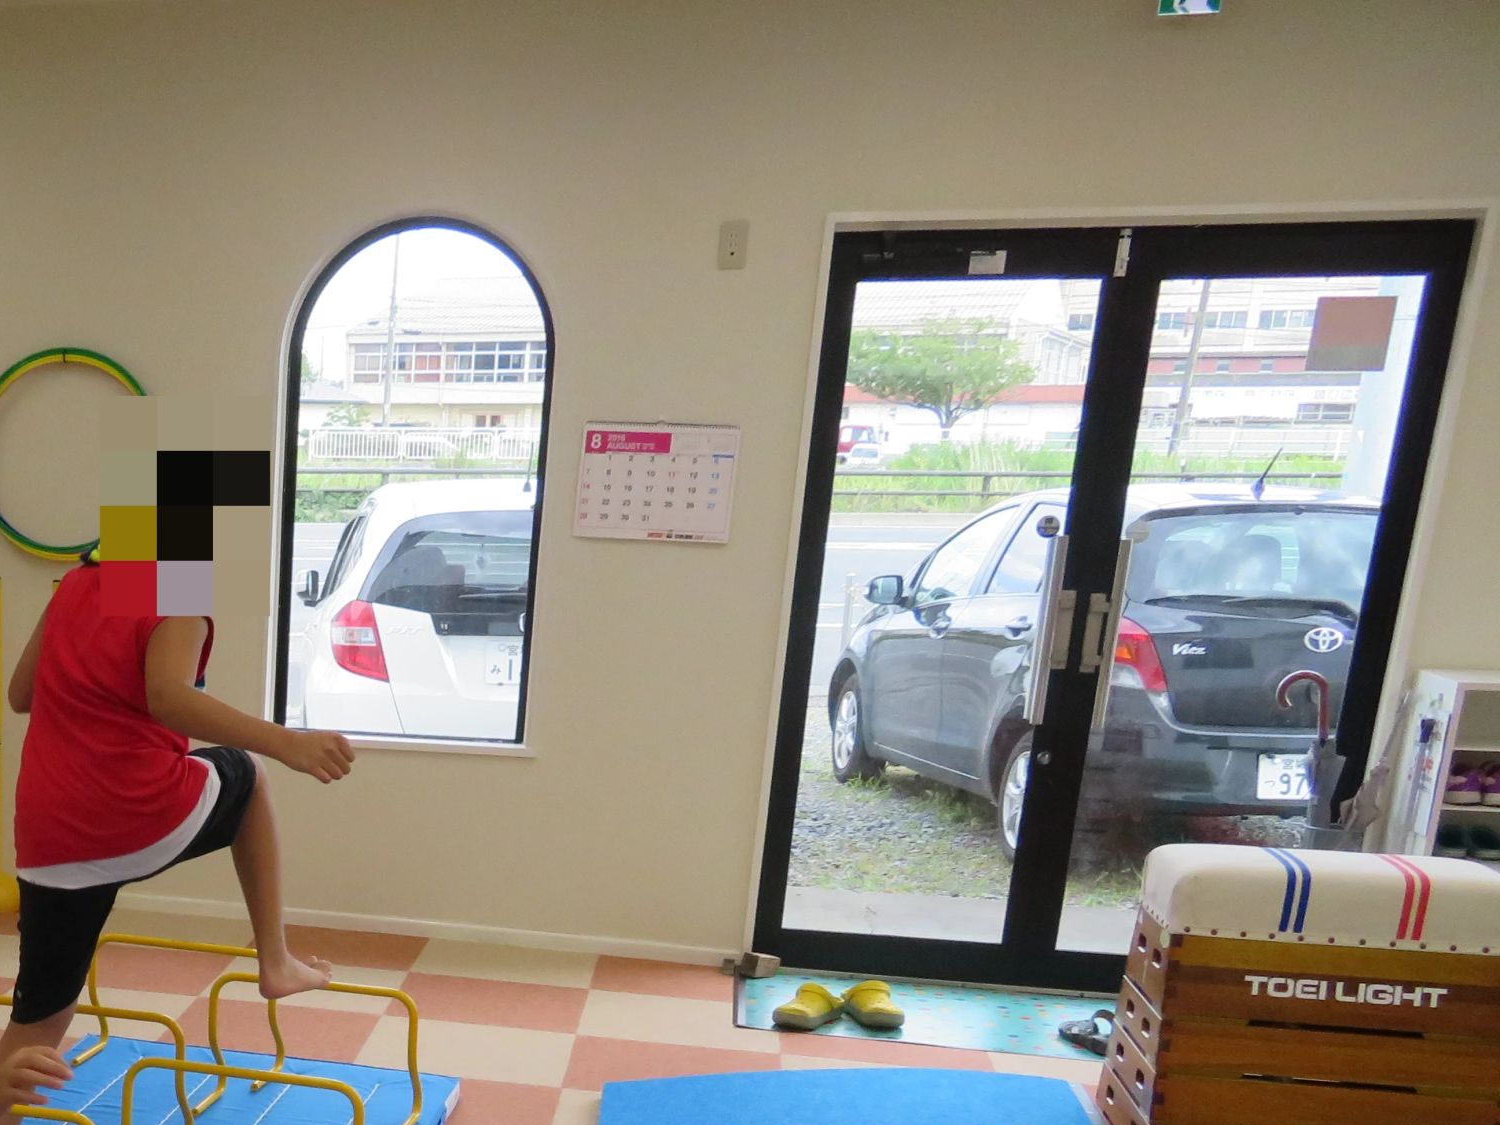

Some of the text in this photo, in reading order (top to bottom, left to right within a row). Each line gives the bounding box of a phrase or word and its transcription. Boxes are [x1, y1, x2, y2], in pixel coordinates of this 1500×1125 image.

[591, 433, 602, 449] 8
[1172, 642, 1207, 656] Vitz
[490, 664, 501, 675] み
[1264, 779, 1276, 788] つ
[1244, 975, 1448, 1009] TOEI LIGHT
